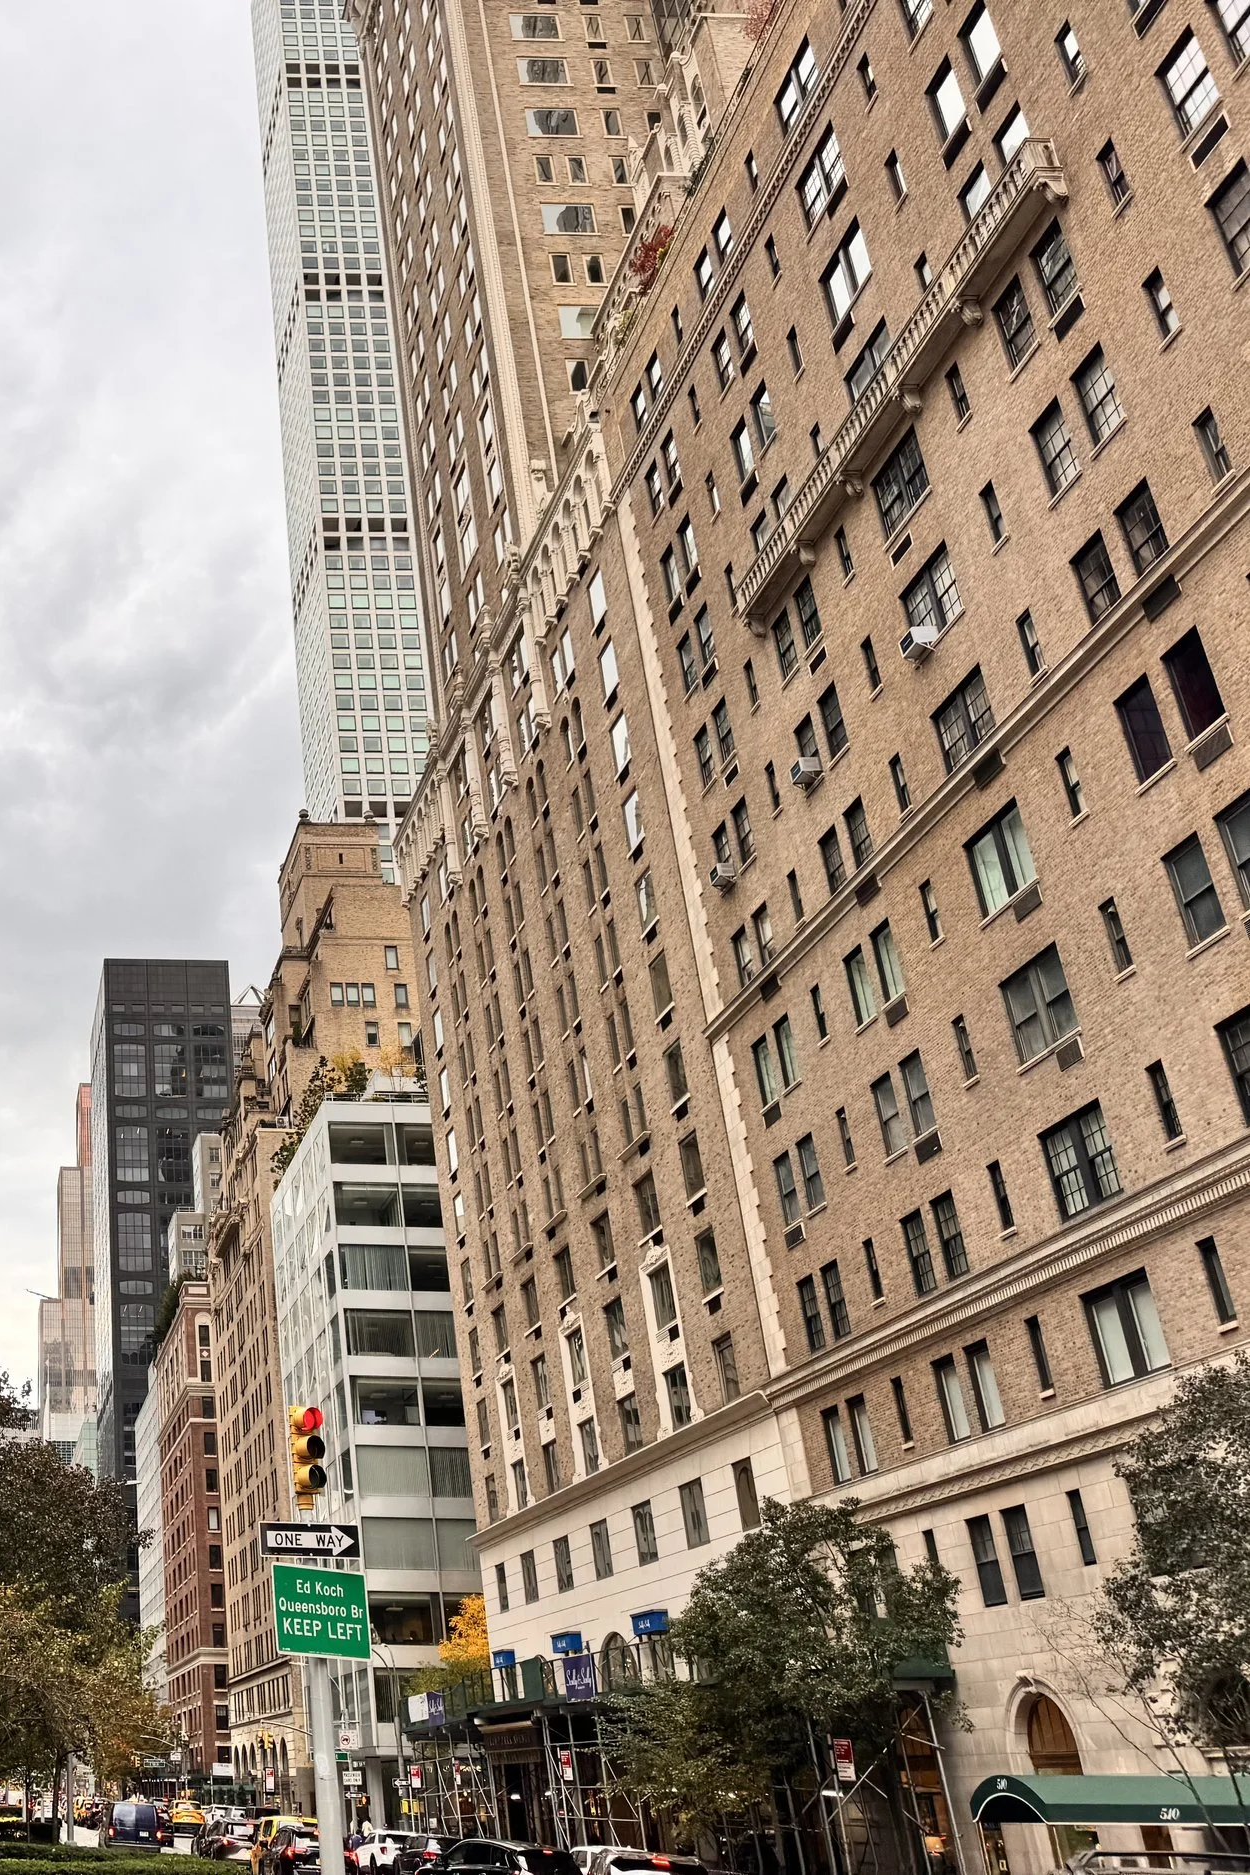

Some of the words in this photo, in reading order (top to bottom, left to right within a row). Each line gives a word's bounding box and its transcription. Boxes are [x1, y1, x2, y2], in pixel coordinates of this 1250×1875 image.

[274, 1533, 303, 1546] ONE
[315, 1534, 344, 1548] WAY
[296, 1579, 311, 1594] Ed
[315, 1581, 344, 1598] Koch
[278, 1597, 347, 1617] Queensboro
[351, 1605, 363, 1619] Br
[283, 1617, 322, 1637] KEEP
[327, 1622, 362, 1641] LEFT
[996, 1778, 1008, 1790] 510
[1159, 1807, 1180, 1821] 510
